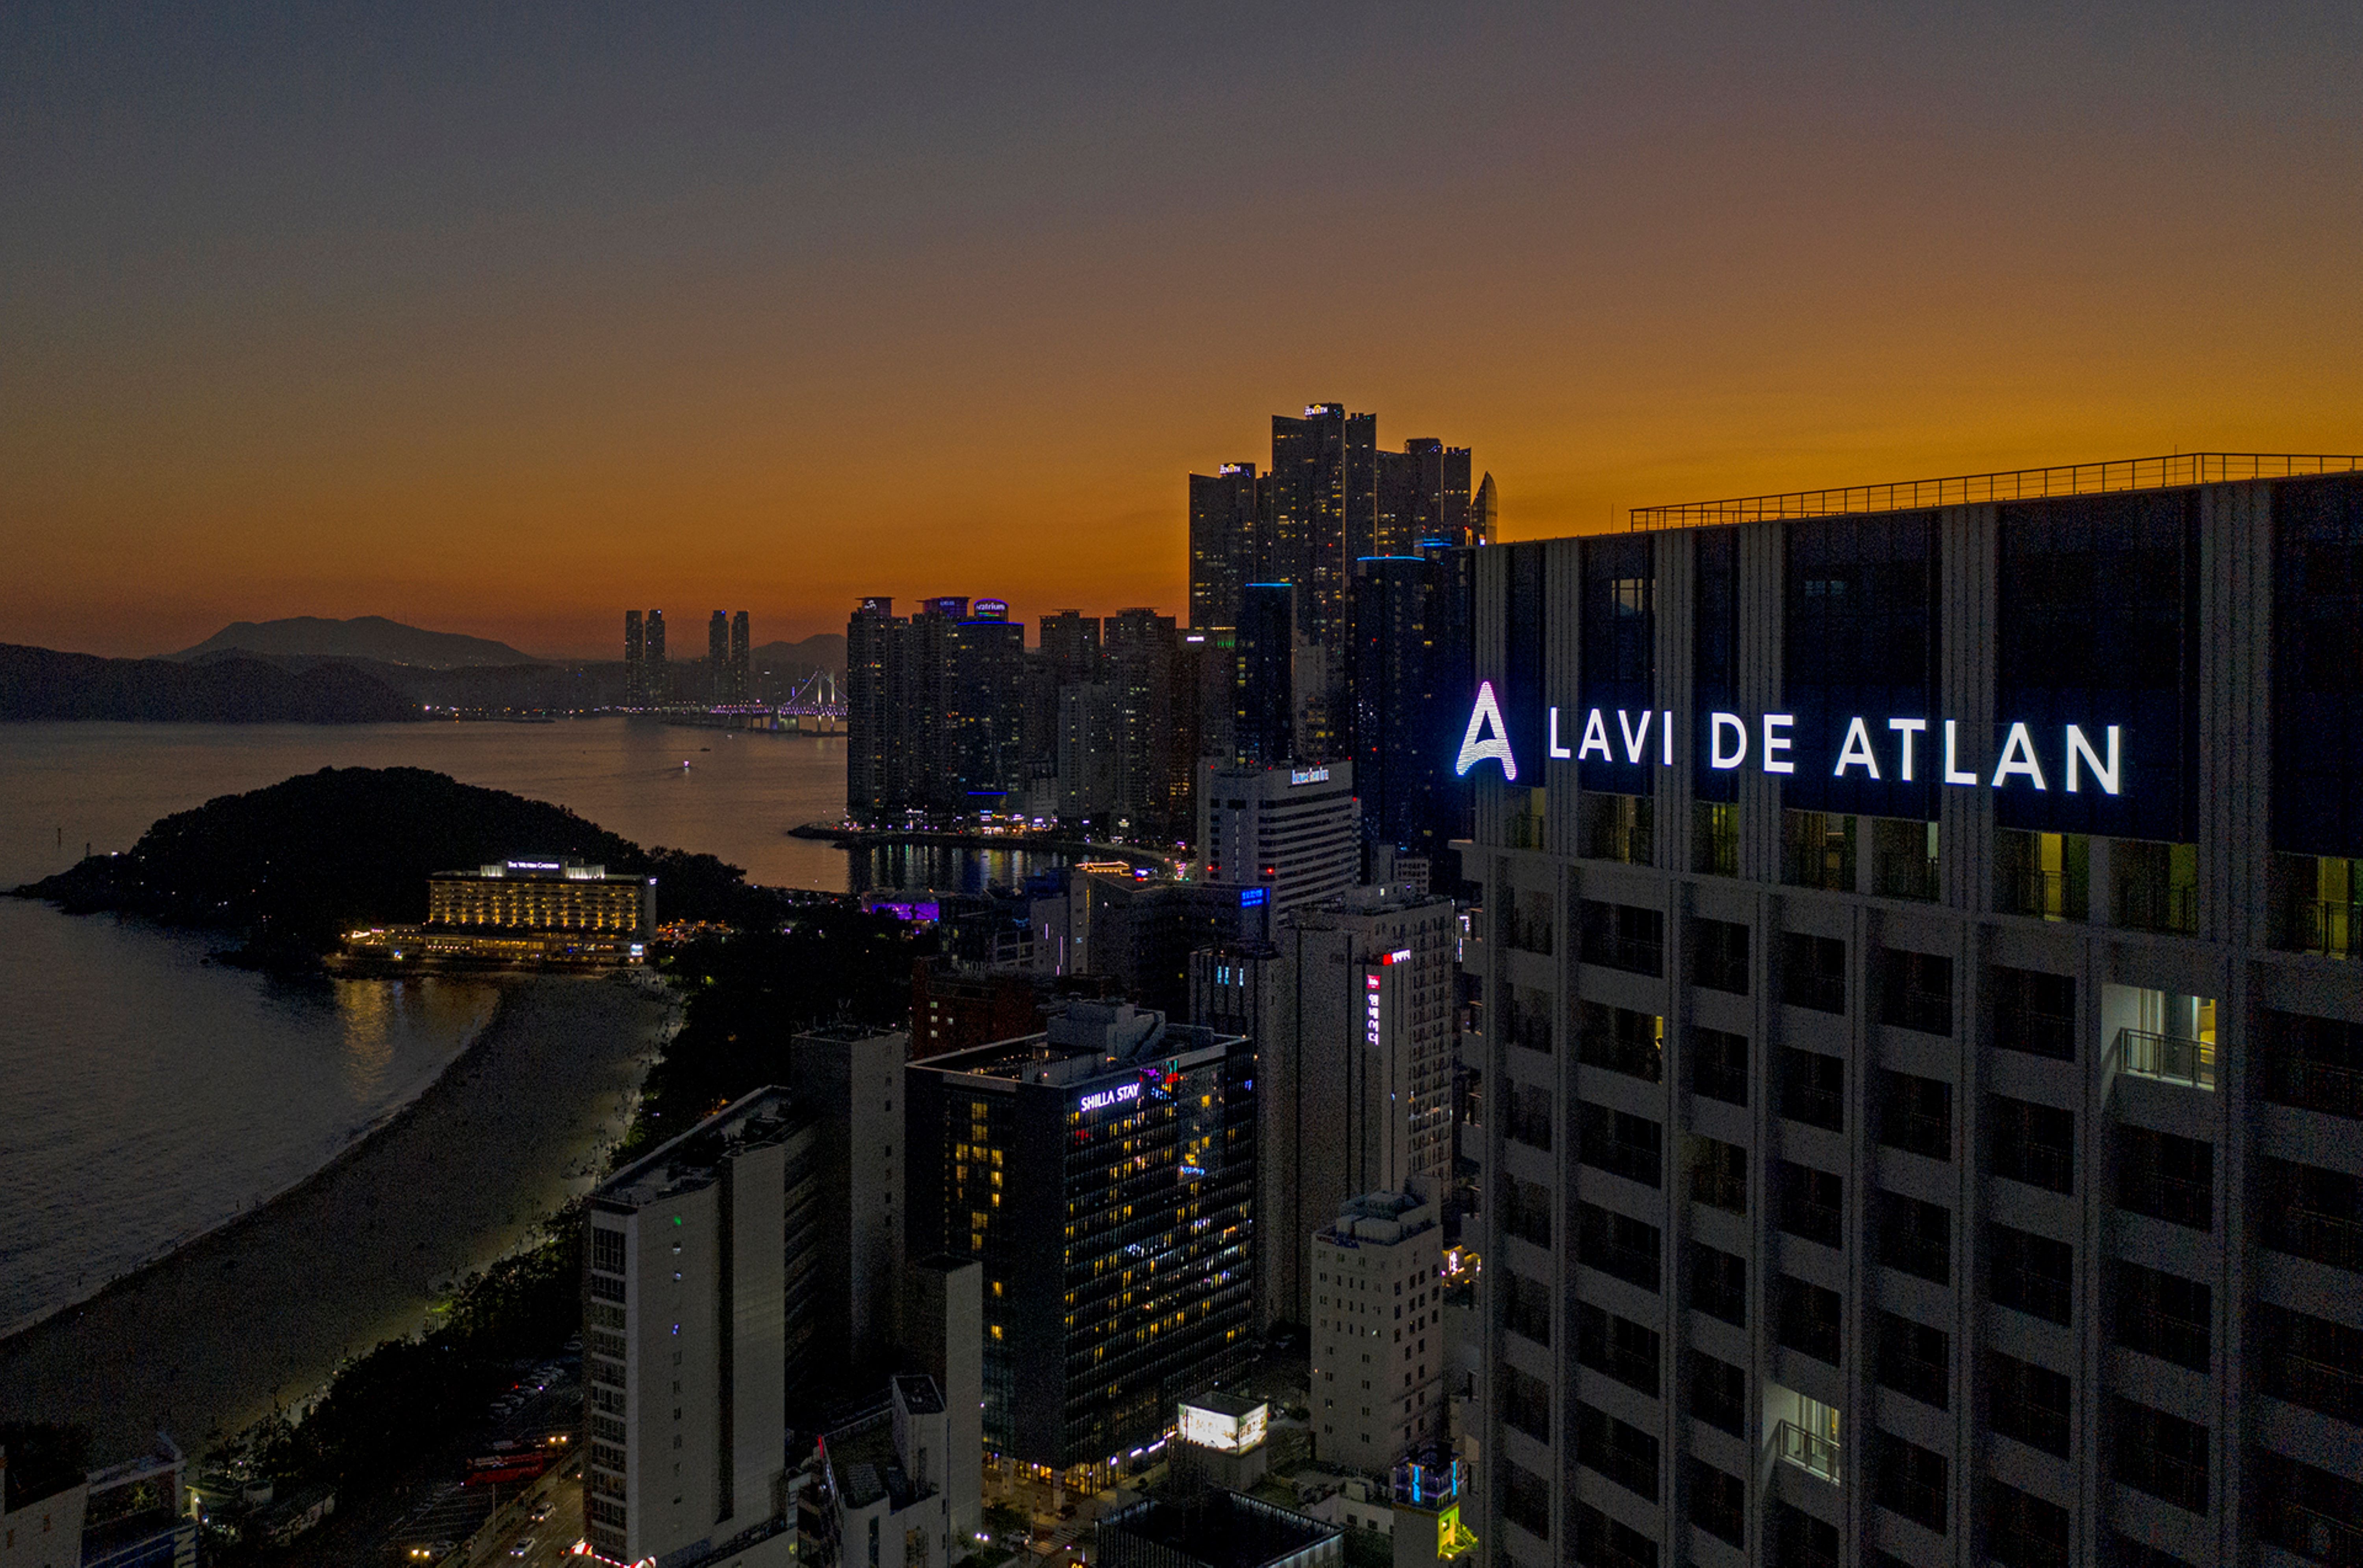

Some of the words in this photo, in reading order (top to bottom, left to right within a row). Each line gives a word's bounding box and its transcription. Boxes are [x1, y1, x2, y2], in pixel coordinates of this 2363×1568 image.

[1550, 707, 1671, 766] LAVI
[1711, 712, 1794, 774] DE
[1834, 717, 2118, 795] ATLAN
[1081, 1090, 1115, 1112] SHILLA
[1117, 1082, 1140, 1102] STAY
